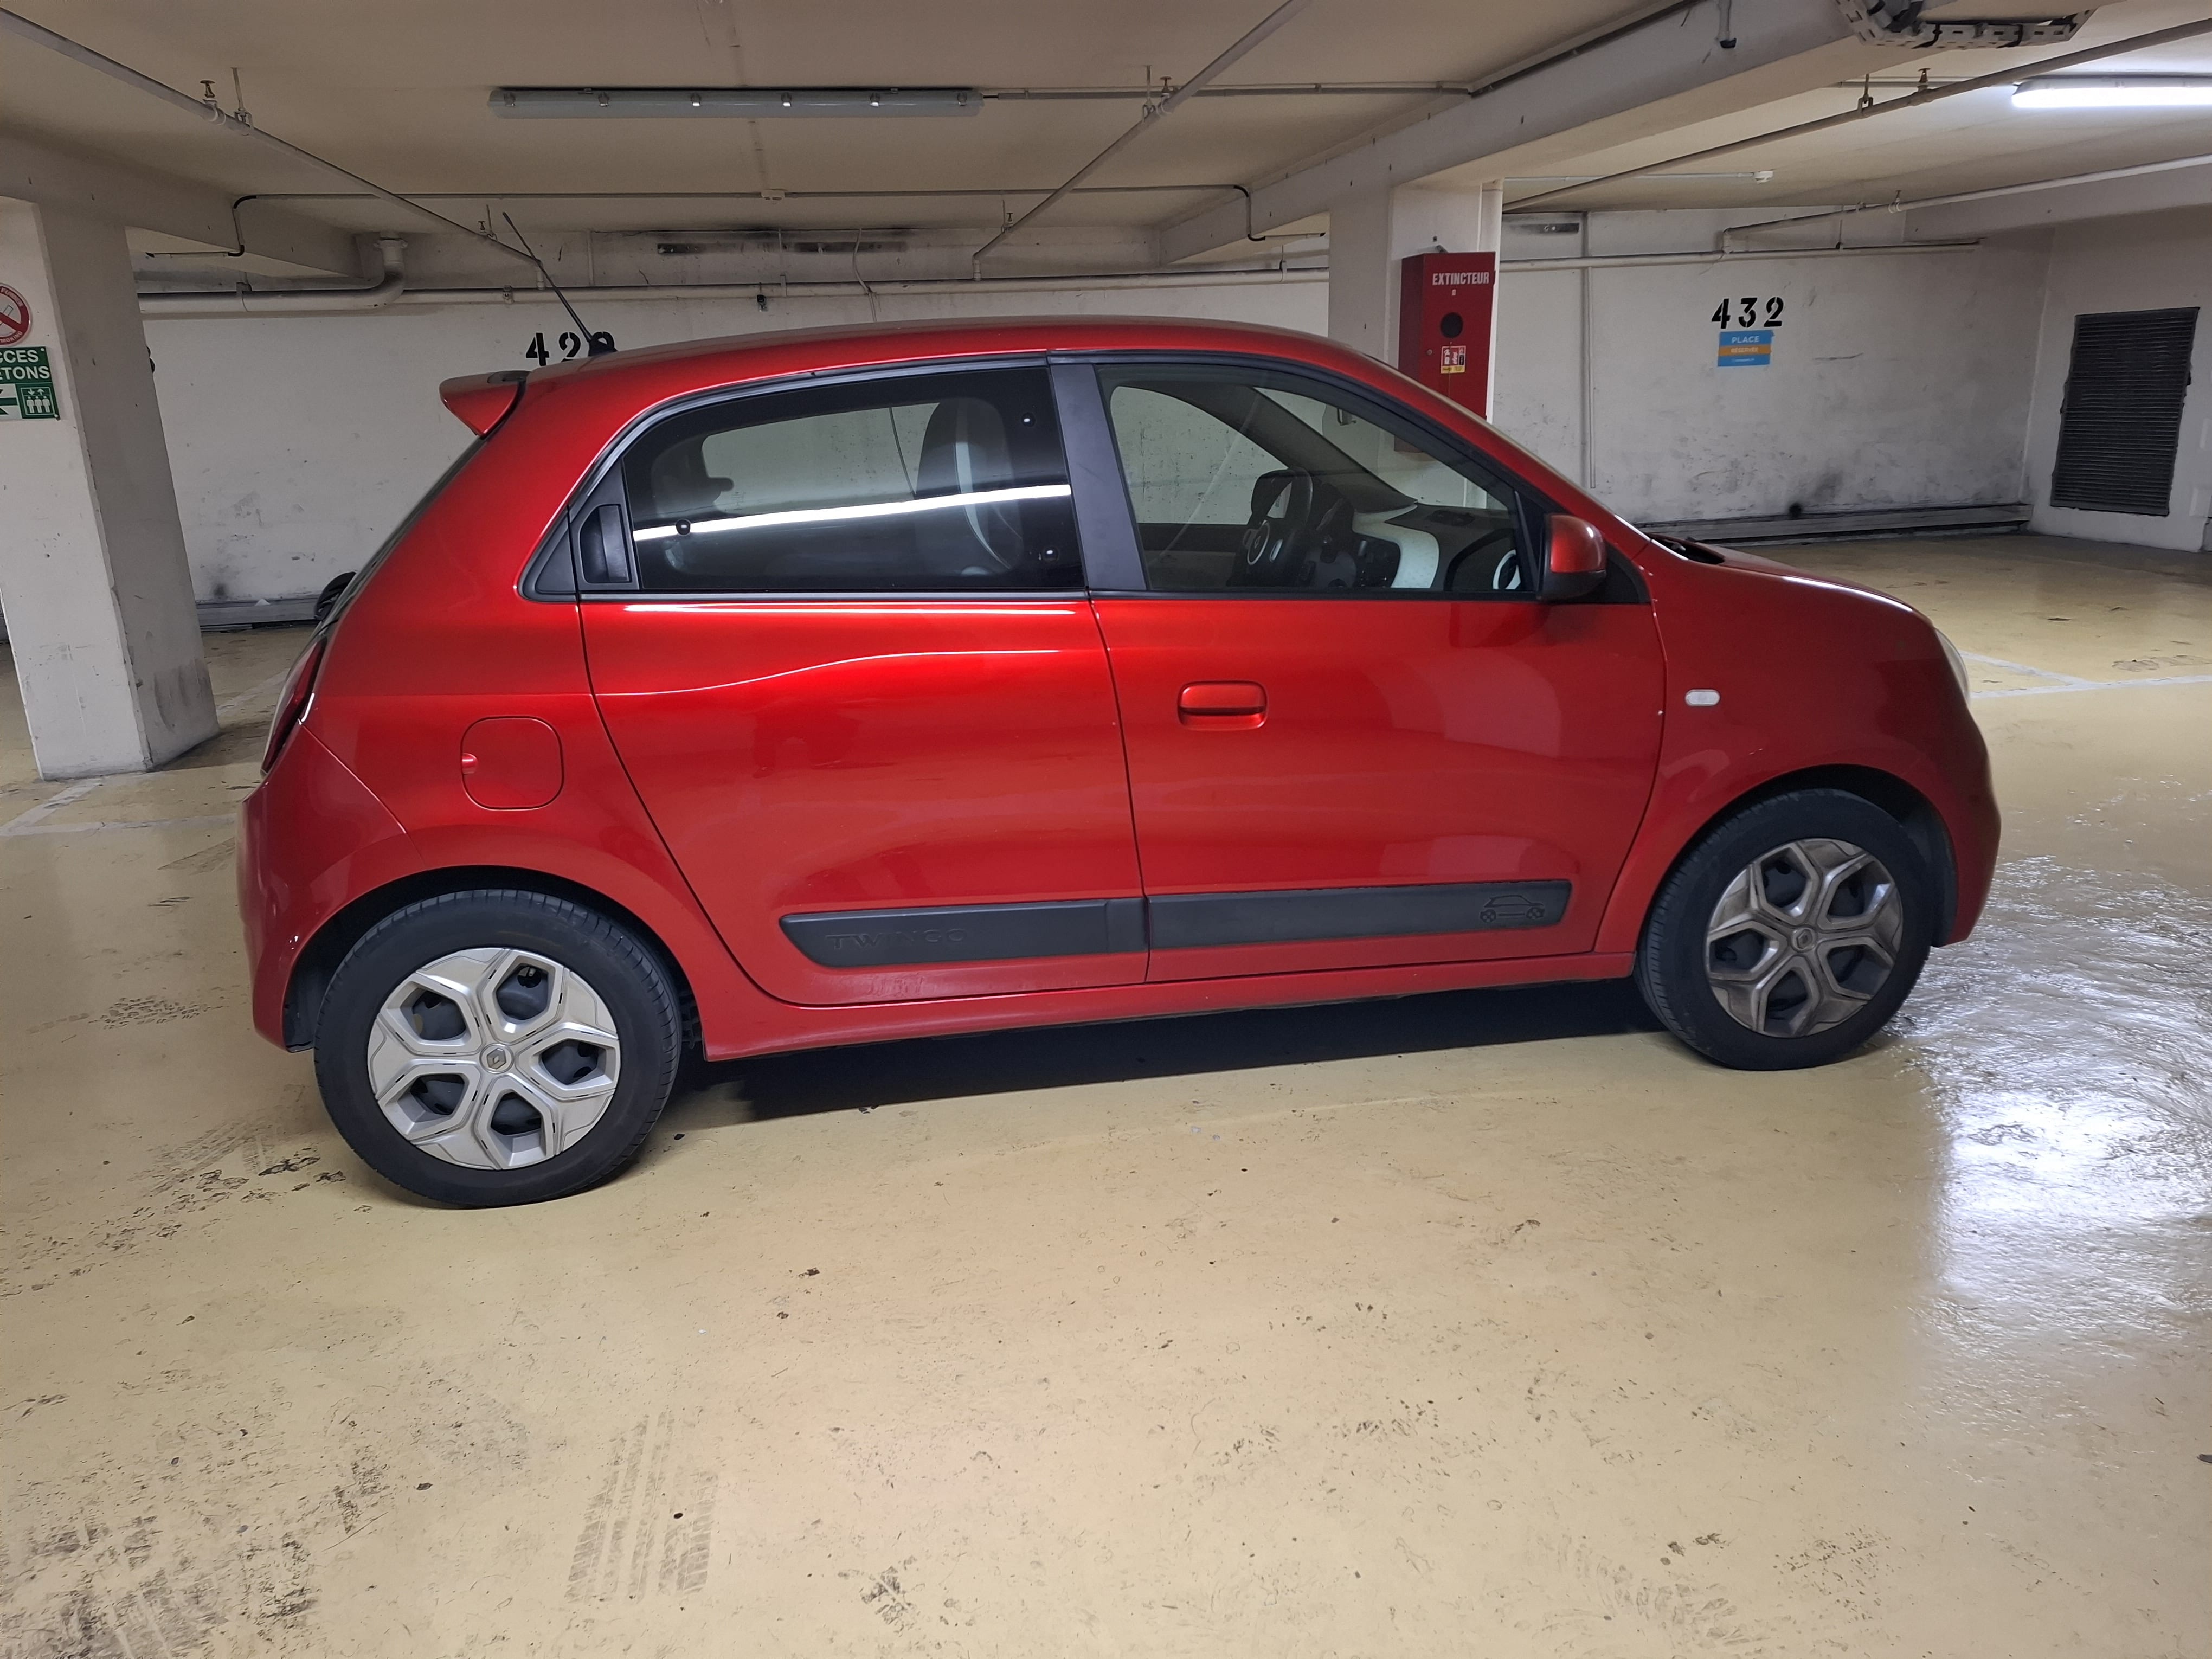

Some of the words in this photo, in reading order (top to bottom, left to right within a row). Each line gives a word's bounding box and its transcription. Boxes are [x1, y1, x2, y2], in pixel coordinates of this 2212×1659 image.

[1432, 272, 1489, 286] EXTINCTEUR
[1711, 297, 1784, 329] 432
[0, 330, 23, 343] MOKING
[1731, 335, 1760, 344] PLACE
[0, 349, 39, 363] CES
[0, 365, 50, 380] TONS
